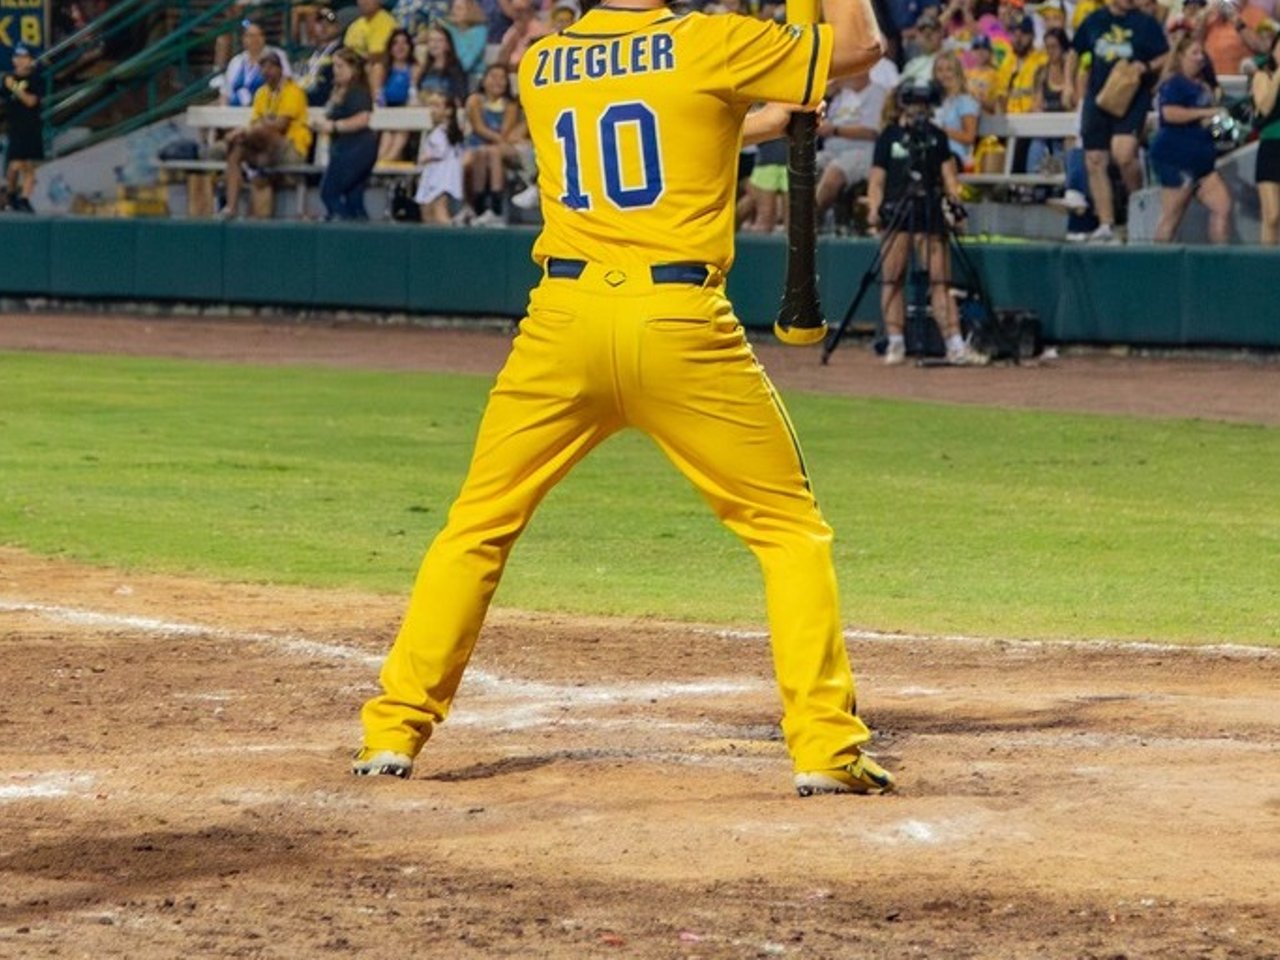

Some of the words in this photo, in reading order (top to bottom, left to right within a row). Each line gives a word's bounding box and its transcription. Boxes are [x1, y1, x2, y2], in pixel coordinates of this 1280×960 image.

[21, 14, 40, 47] B
[533, 33, 674, 88] ZIEGLER
[553, 100, 665, 211] 10
